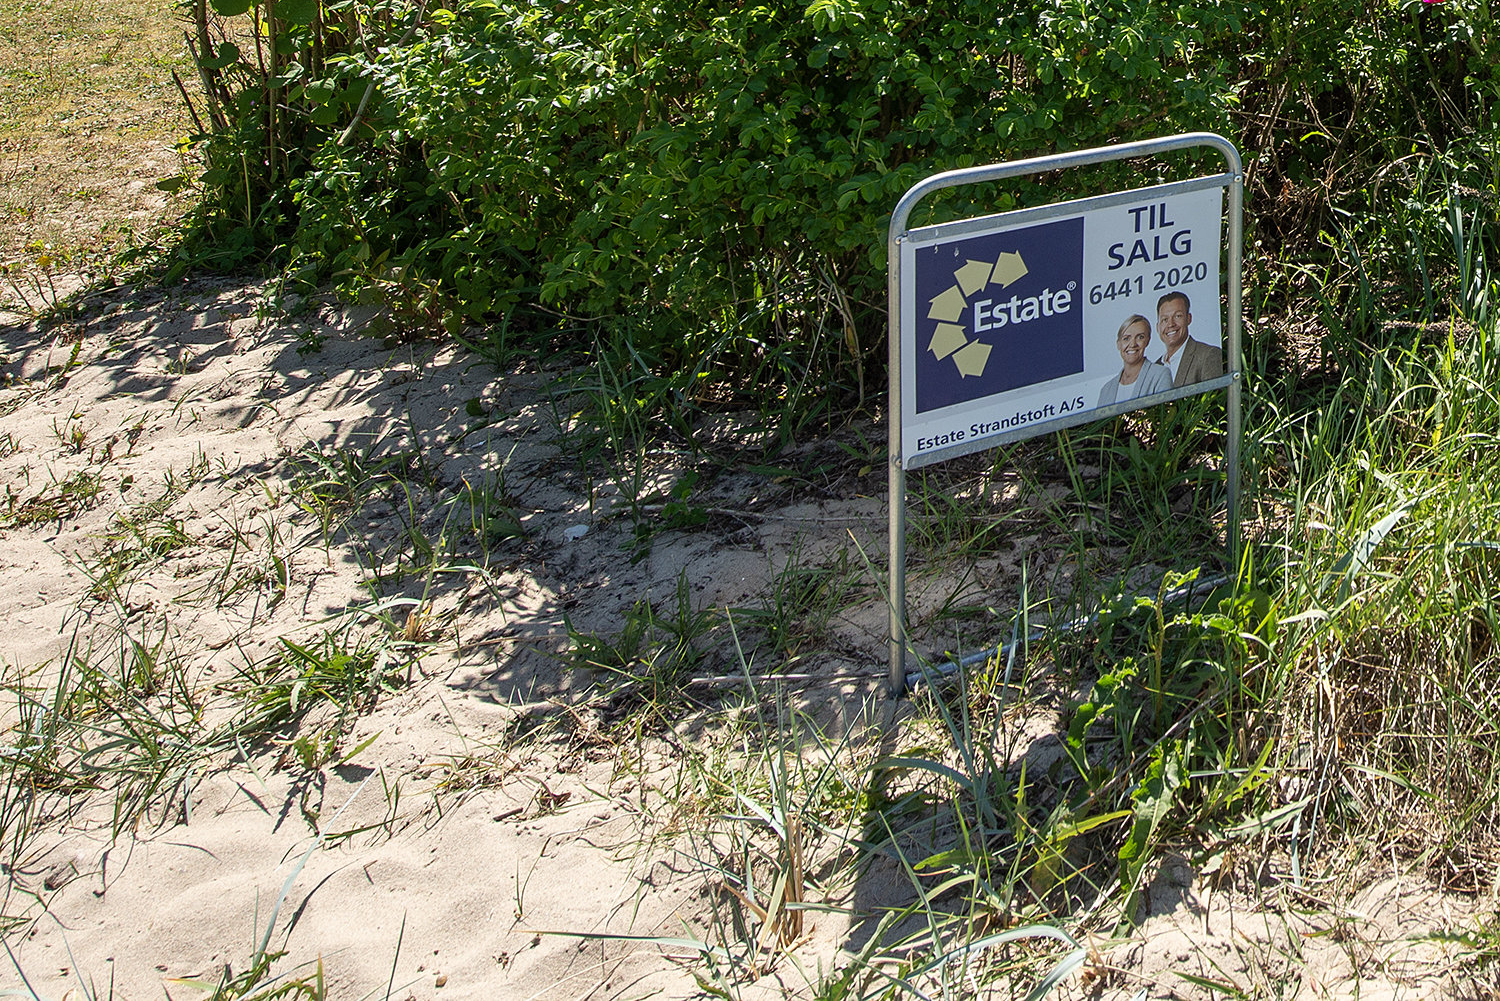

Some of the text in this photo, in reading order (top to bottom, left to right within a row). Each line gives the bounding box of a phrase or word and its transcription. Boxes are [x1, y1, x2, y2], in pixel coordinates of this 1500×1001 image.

[1128, 202, 1174, 234] TIL
[1107, 229, 1192, 271] SALG
[1089, 261, 1208, 306] 6441 2020
[917, 396, 1086, 452] Estate Strandstoft A/S
